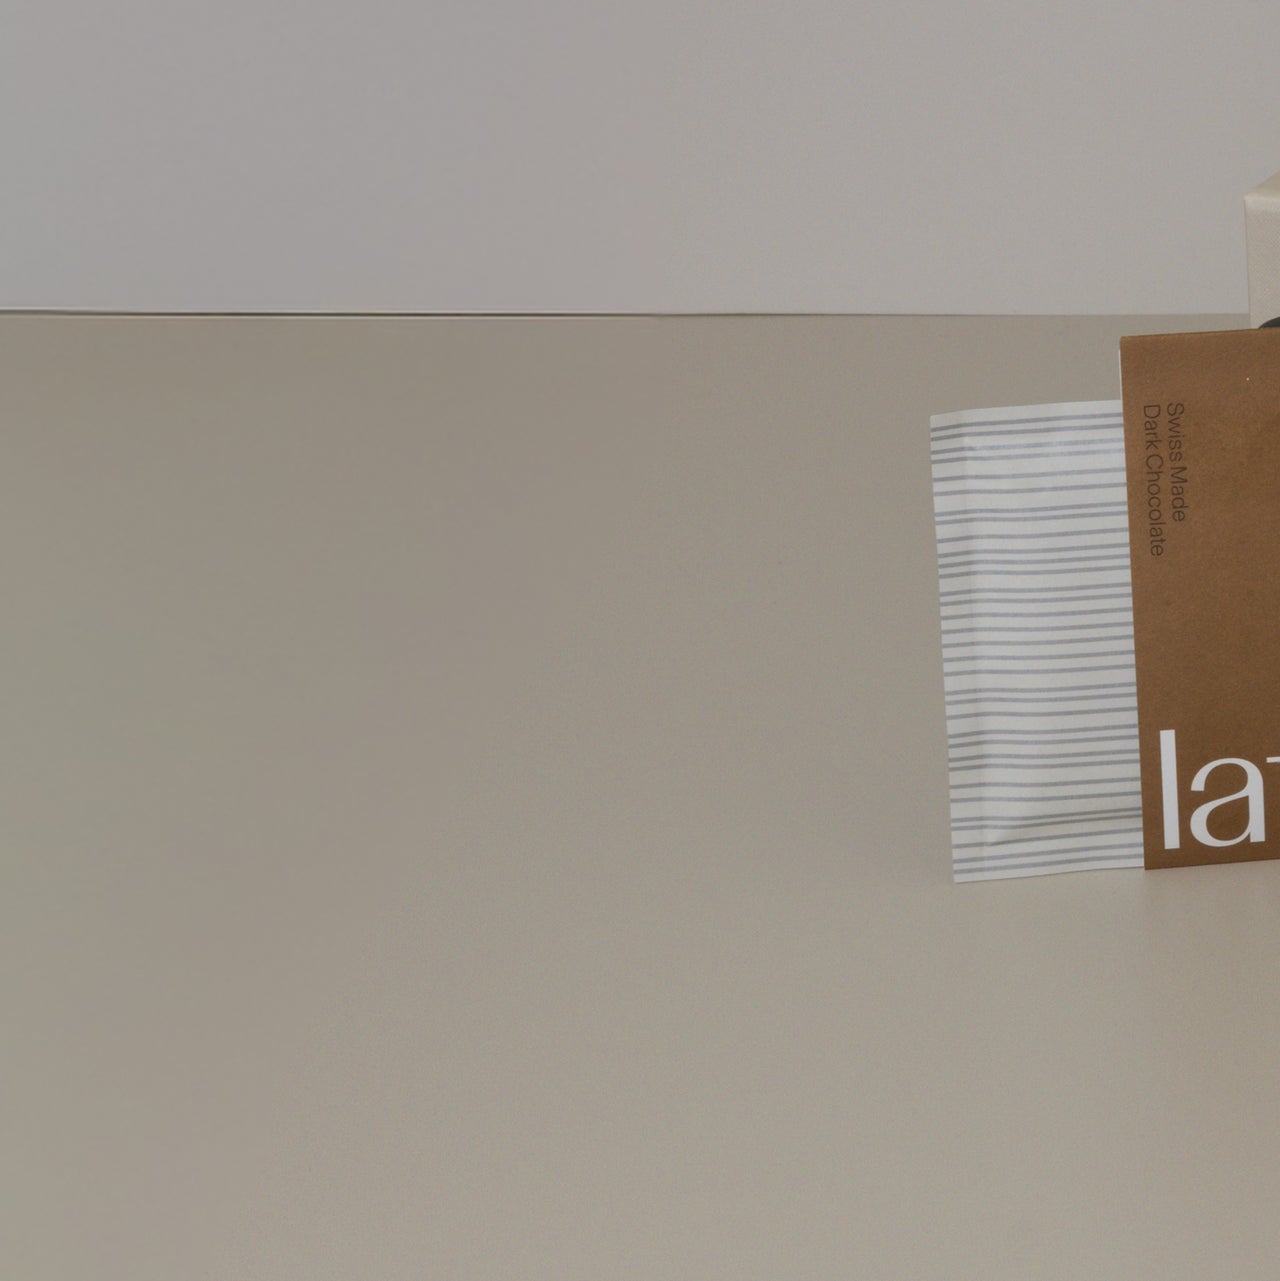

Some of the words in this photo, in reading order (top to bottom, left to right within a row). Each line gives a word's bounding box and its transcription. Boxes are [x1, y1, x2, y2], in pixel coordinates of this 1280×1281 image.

[1143, 404, 1162, 450] Dark
[1166, 402, 1185, 462] Swiss
[1145, 454, 1167, 557] Chocolate
[1169, 466, 1189, 522] Made
